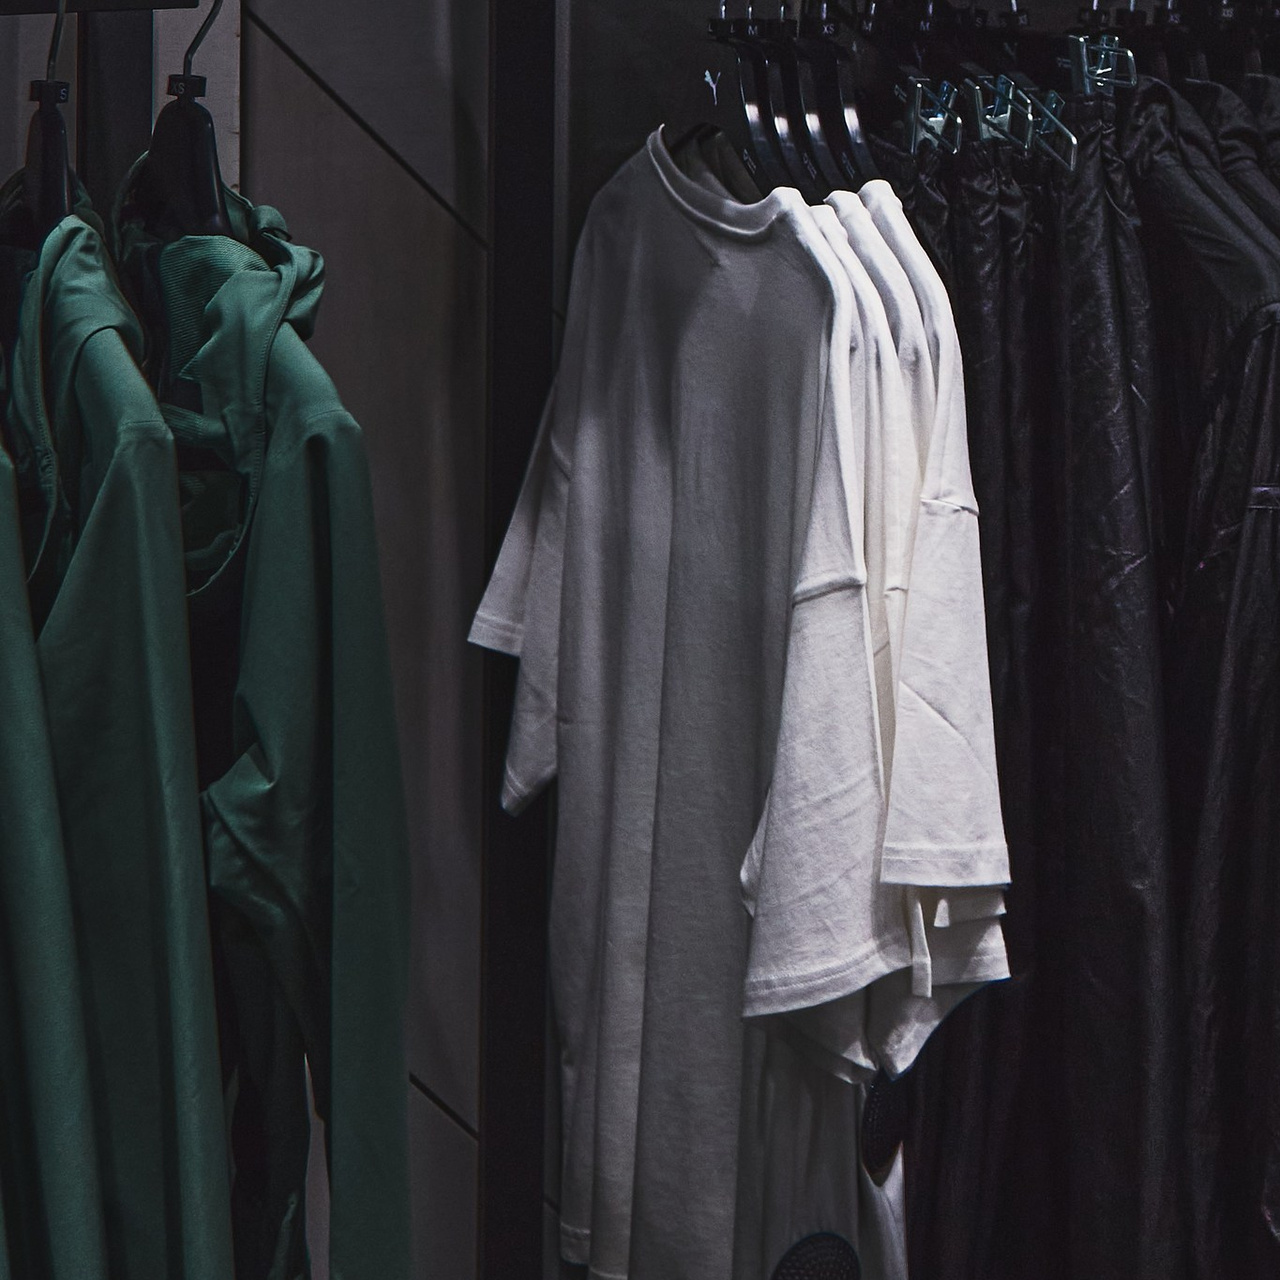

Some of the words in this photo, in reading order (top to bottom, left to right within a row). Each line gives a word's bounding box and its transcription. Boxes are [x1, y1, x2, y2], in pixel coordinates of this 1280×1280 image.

[747, 25, 758, 35] M
[822, 23, 835, 34] XS
[920, 20, 930, 31] M
[172, 81, 185, 95] XS
[60, 88, 68, 100] S
